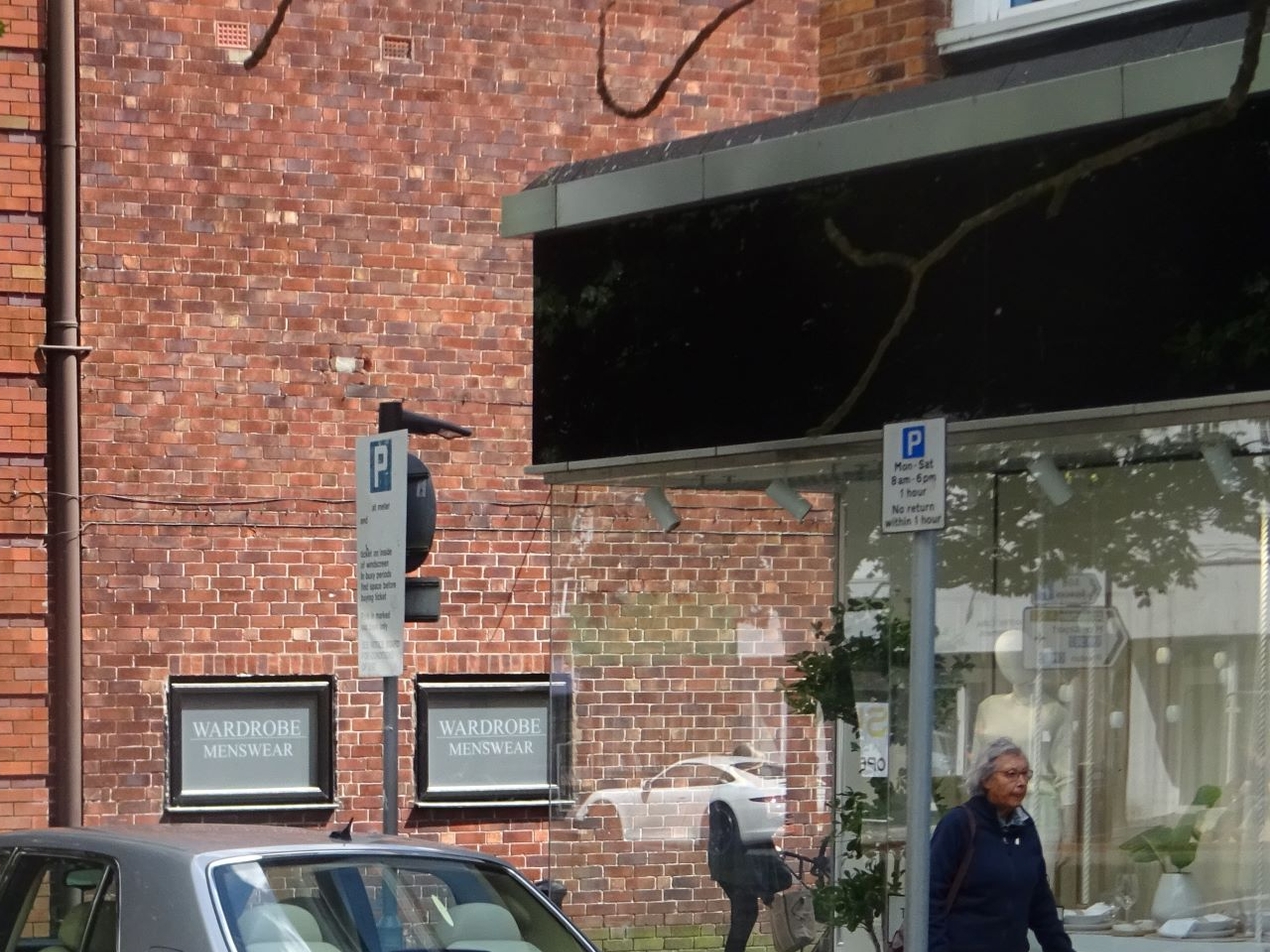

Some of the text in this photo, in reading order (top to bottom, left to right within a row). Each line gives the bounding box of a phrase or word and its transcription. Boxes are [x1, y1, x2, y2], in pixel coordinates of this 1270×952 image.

[908, 429, 922, 456] P
[374, 445, 388, 488] P
[906, 488, 927, 498] hour
[892, 503, 935, 515] No return
[885, 516, 912, 527] within
[920, 515, 942, 525] hour
[192, 719, 301, 738] WARDROBE
[439, 718, 541, 737] WARDROBE
[204, 743, 293, 759] MENSWEAR
[449, 740, 534, 756] MENSWEAR
